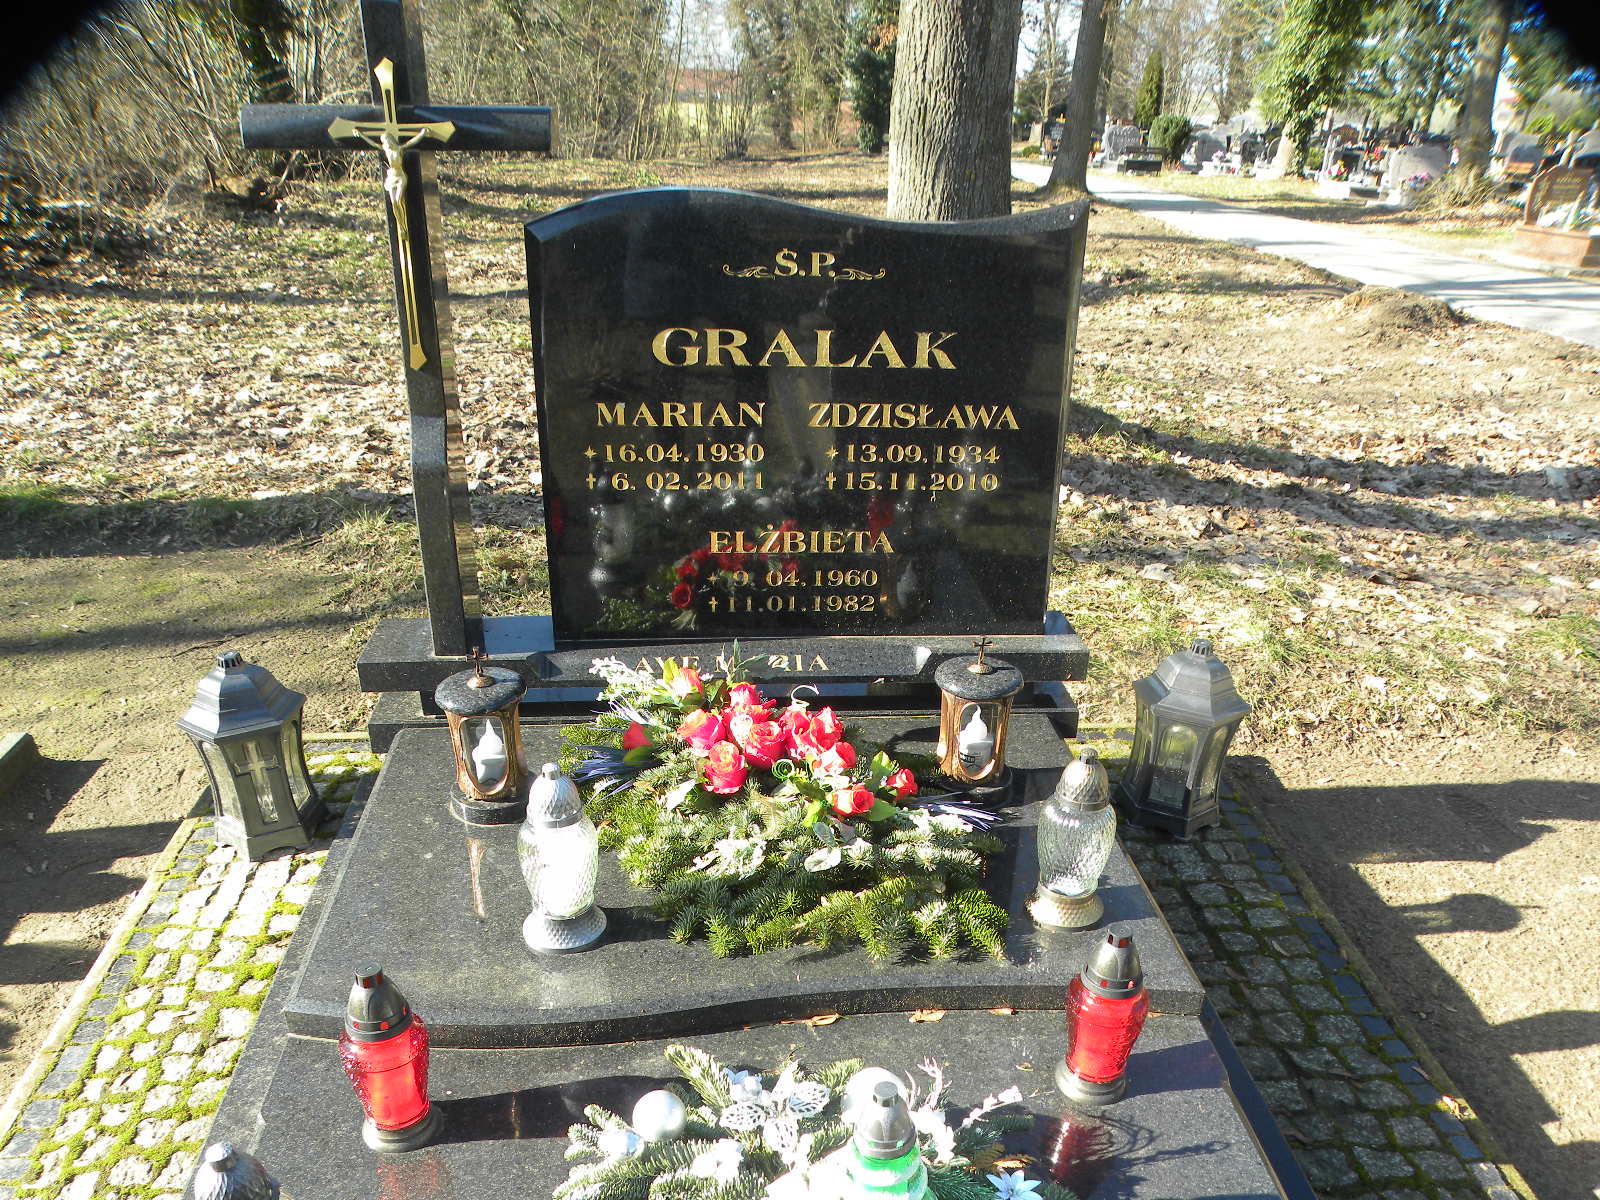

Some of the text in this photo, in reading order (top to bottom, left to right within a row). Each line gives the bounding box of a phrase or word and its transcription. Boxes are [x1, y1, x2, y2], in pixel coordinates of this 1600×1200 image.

[652, 327, 958, 370] GRALAK
[596, 402, 765, 427] MARIAN
[808, 403, 1020, 430] ZDZISŁAWA
[604, 443, 765, 463] 16.04.1930
[847, 444, 1000, 464] 13.09.1934
[845, 472, 999, 491] 15.11.2010
[709, 524, 895, 554] ELŻBIETA
[728, 596, 876, 613] 11.01.1982
[714, 654, 830, 673] MRIA
